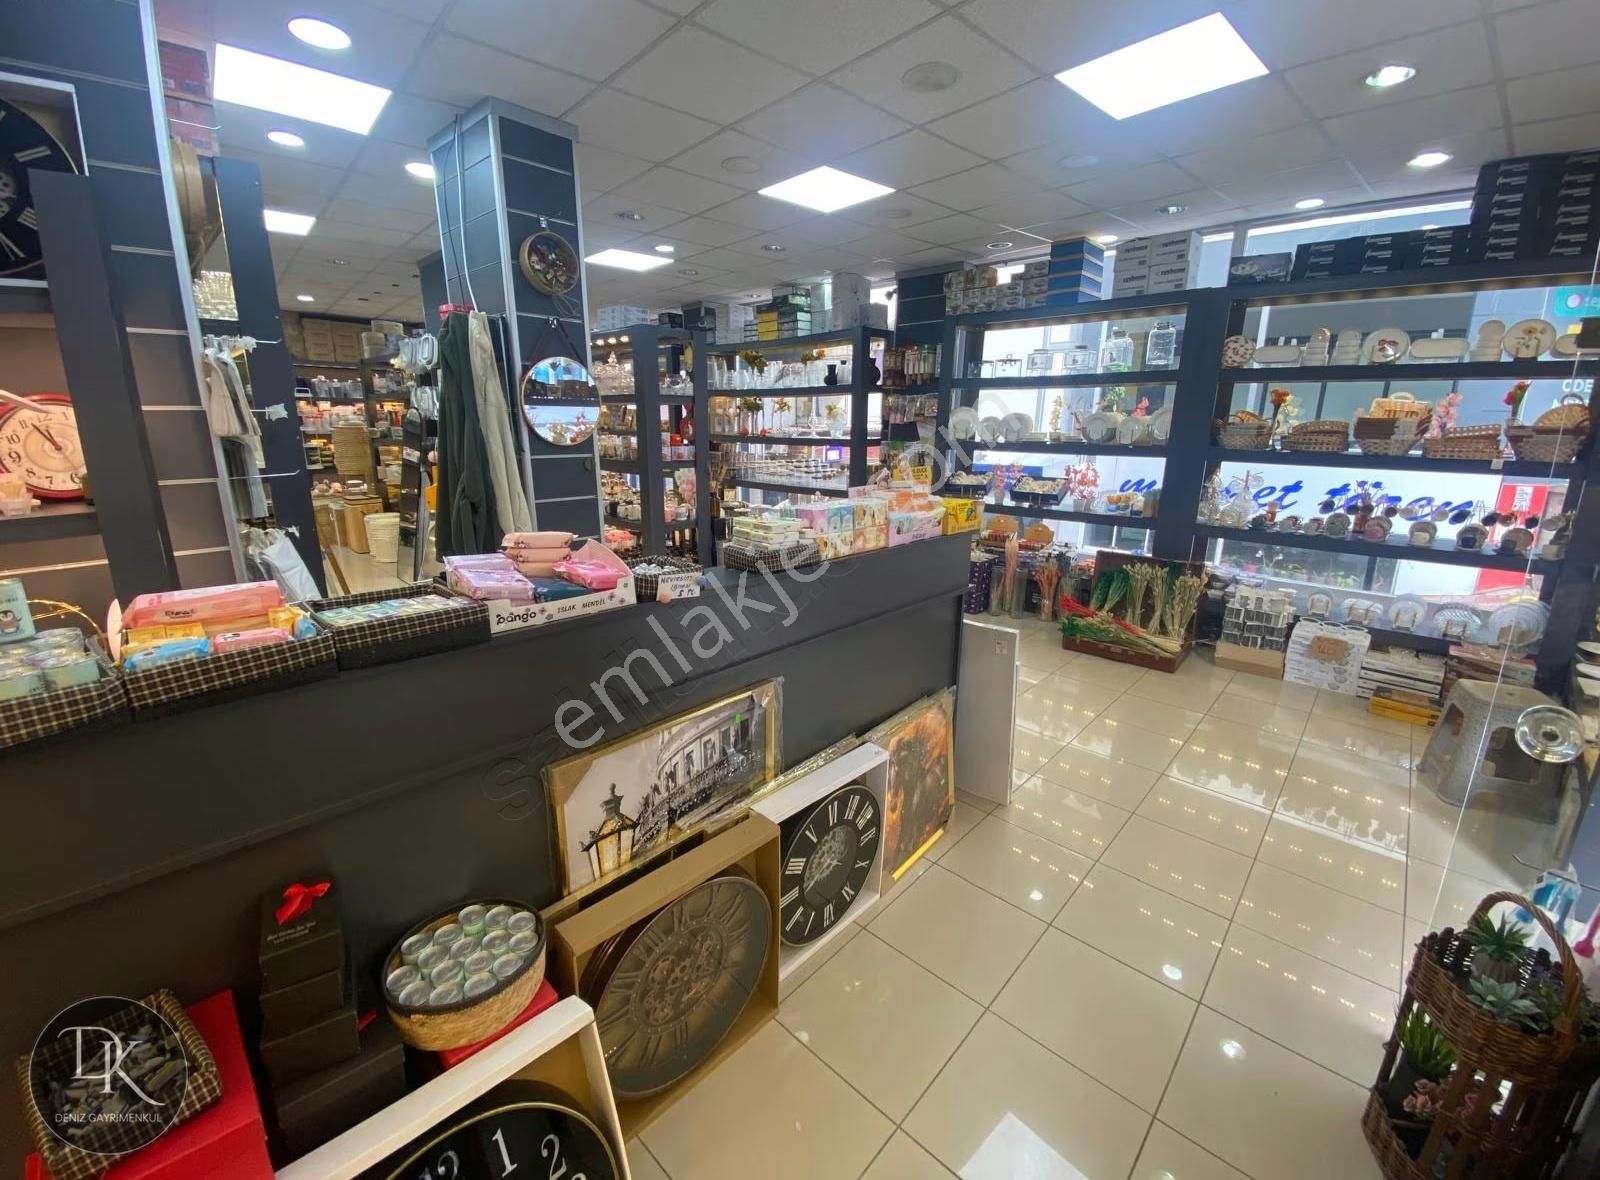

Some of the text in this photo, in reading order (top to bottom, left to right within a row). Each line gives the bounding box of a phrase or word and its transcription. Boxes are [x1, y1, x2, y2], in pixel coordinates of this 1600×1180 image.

[6, 433, 21, 445] 10
[8, 451, 21, 463] 9
[25, 467, 36, 478] 8
[45, 475, 53, 485] 7
[558, 604, 577, 613] ISLAK
[492, 1128, 518, 1177] 1
[541, 1134, 567, 1180] 2
